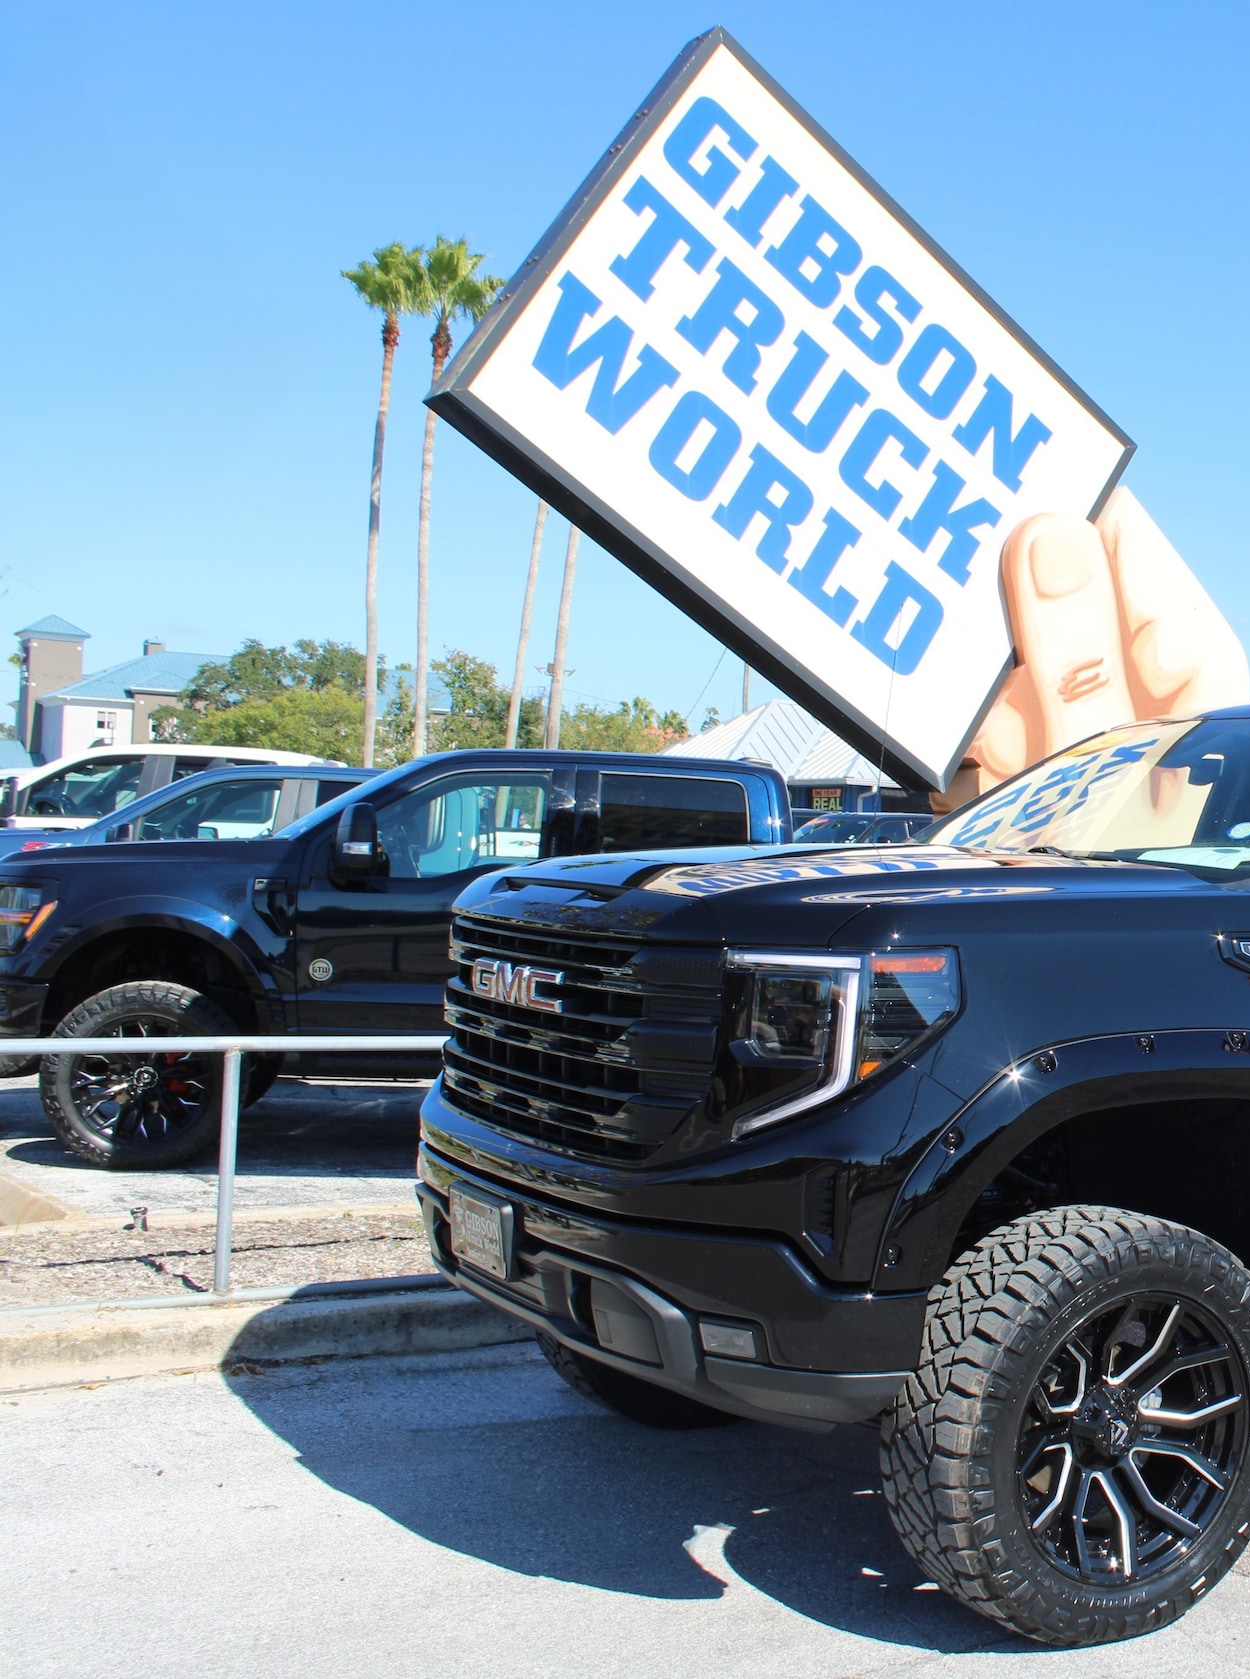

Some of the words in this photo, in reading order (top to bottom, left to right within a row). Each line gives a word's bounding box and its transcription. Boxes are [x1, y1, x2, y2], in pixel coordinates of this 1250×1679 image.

[608, 175, 1002, 587] TRUCK
[662, 96, 1053, 494] GIBSON
[532, 270, 945, 676] WORLD
[813, 797, 843, 811] REAL
[472, 957, 565, 1014] GMC
[465, 1210, 500, 1240] GIBSON
